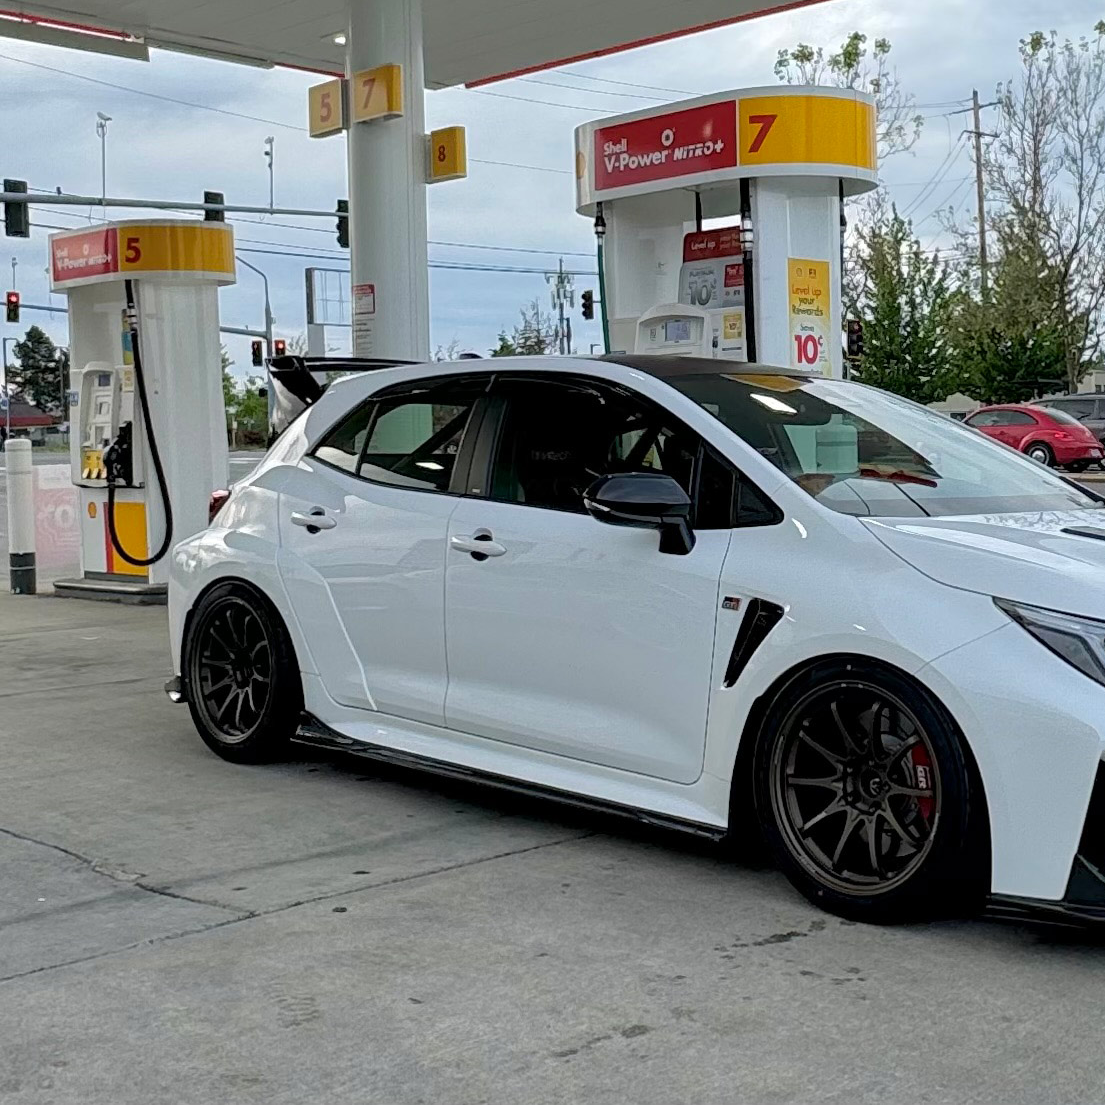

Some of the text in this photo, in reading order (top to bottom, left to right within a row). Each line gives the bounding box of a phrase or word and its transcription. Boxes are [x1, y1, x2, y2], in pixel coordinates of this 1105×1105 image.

[361, 77, 376, 110] 7
[319, 92, 332, 123] 5
[747, 114, 778, 154] 7
[437, 144, 446, 163] 8
[603, 138, 628, 155] Shell
[604, 149, 669, 173] V-Power
[125, 237, 142, 264] 5
[791, 284, 822, 299] Level up
[798, 297, 815, 307] your
[791, 304, 823, 316] Rewards
